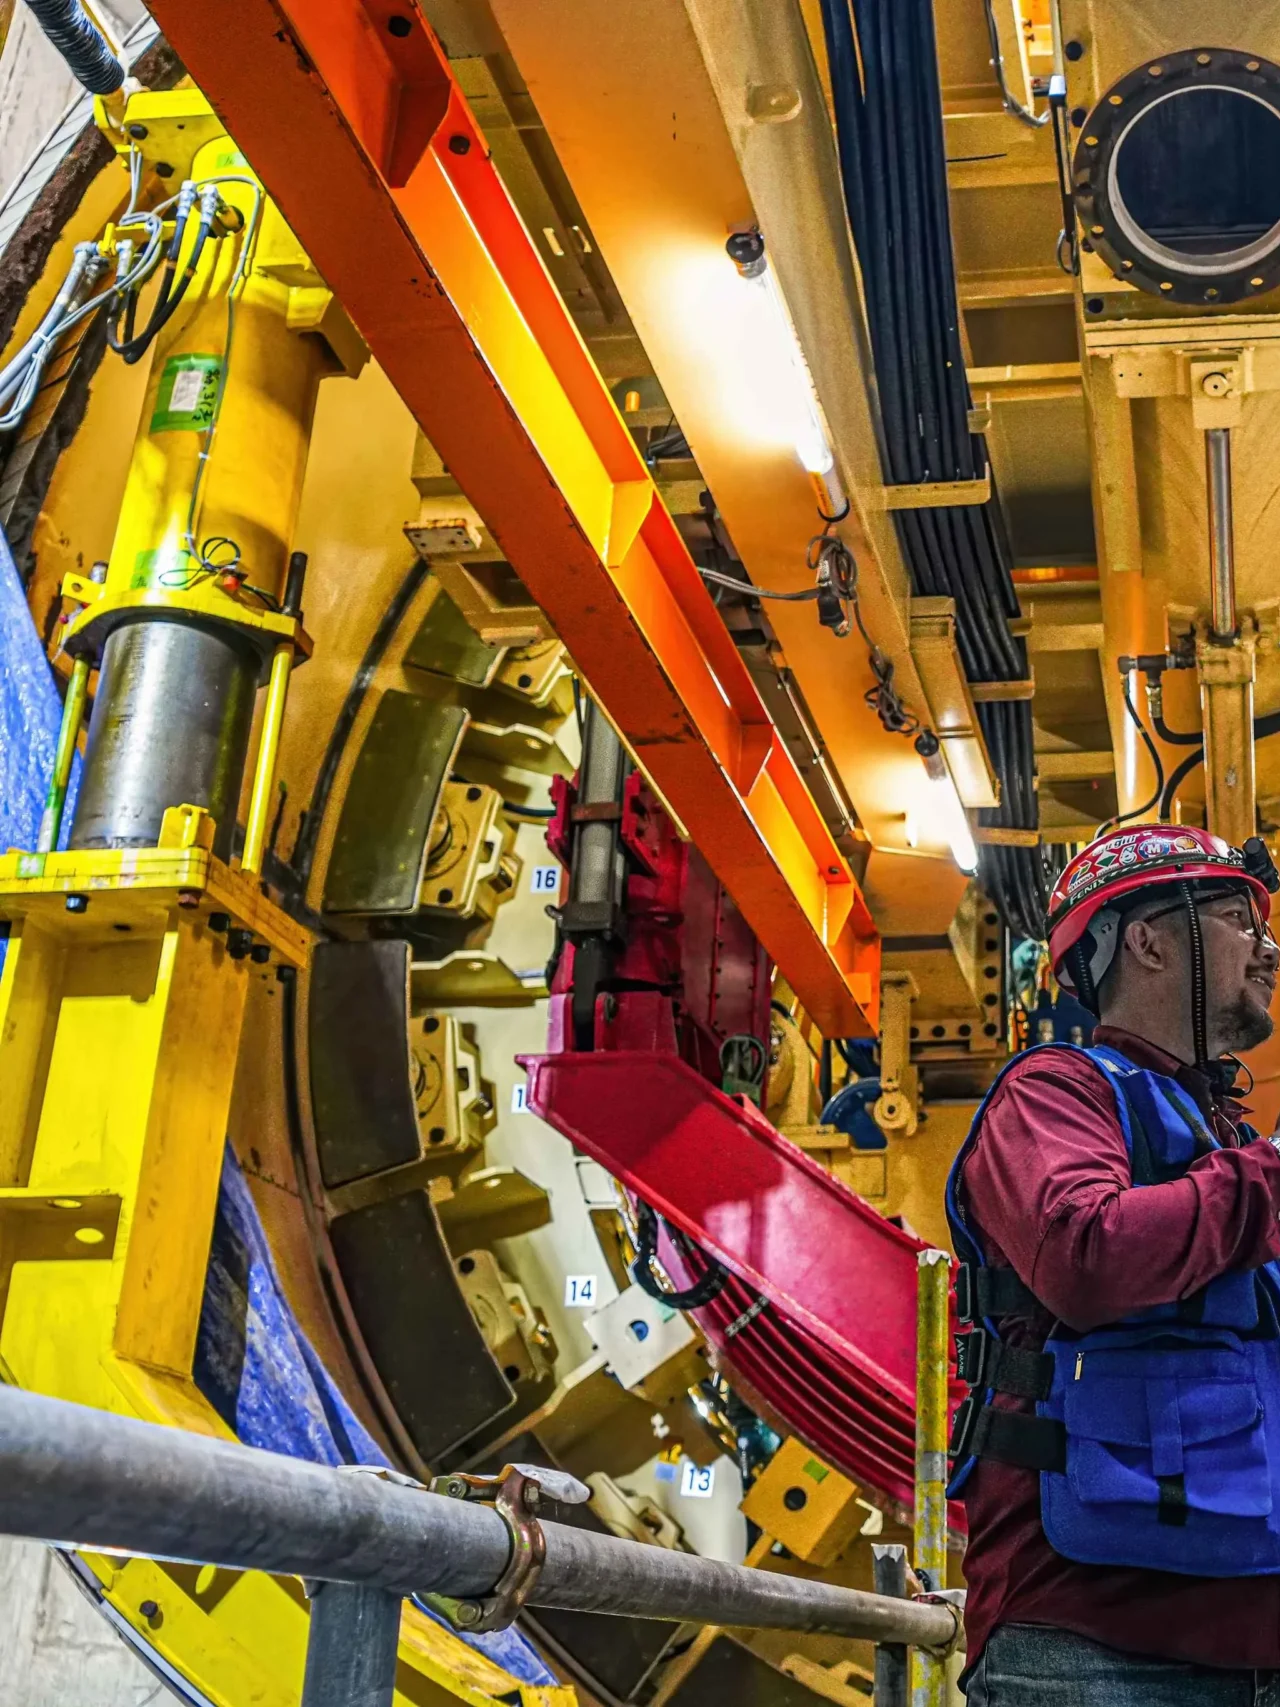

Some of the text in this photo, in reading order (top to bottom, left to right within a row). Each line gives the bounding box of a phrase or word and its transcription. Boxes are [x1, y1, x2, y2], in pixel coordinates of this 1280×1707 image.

[536, 870, 556, 889] 16
[1069, 876, 1106, 905] FENIX
[571, 1280, 592, 1301] 14
[689, 1468, 711, 1491] 13
